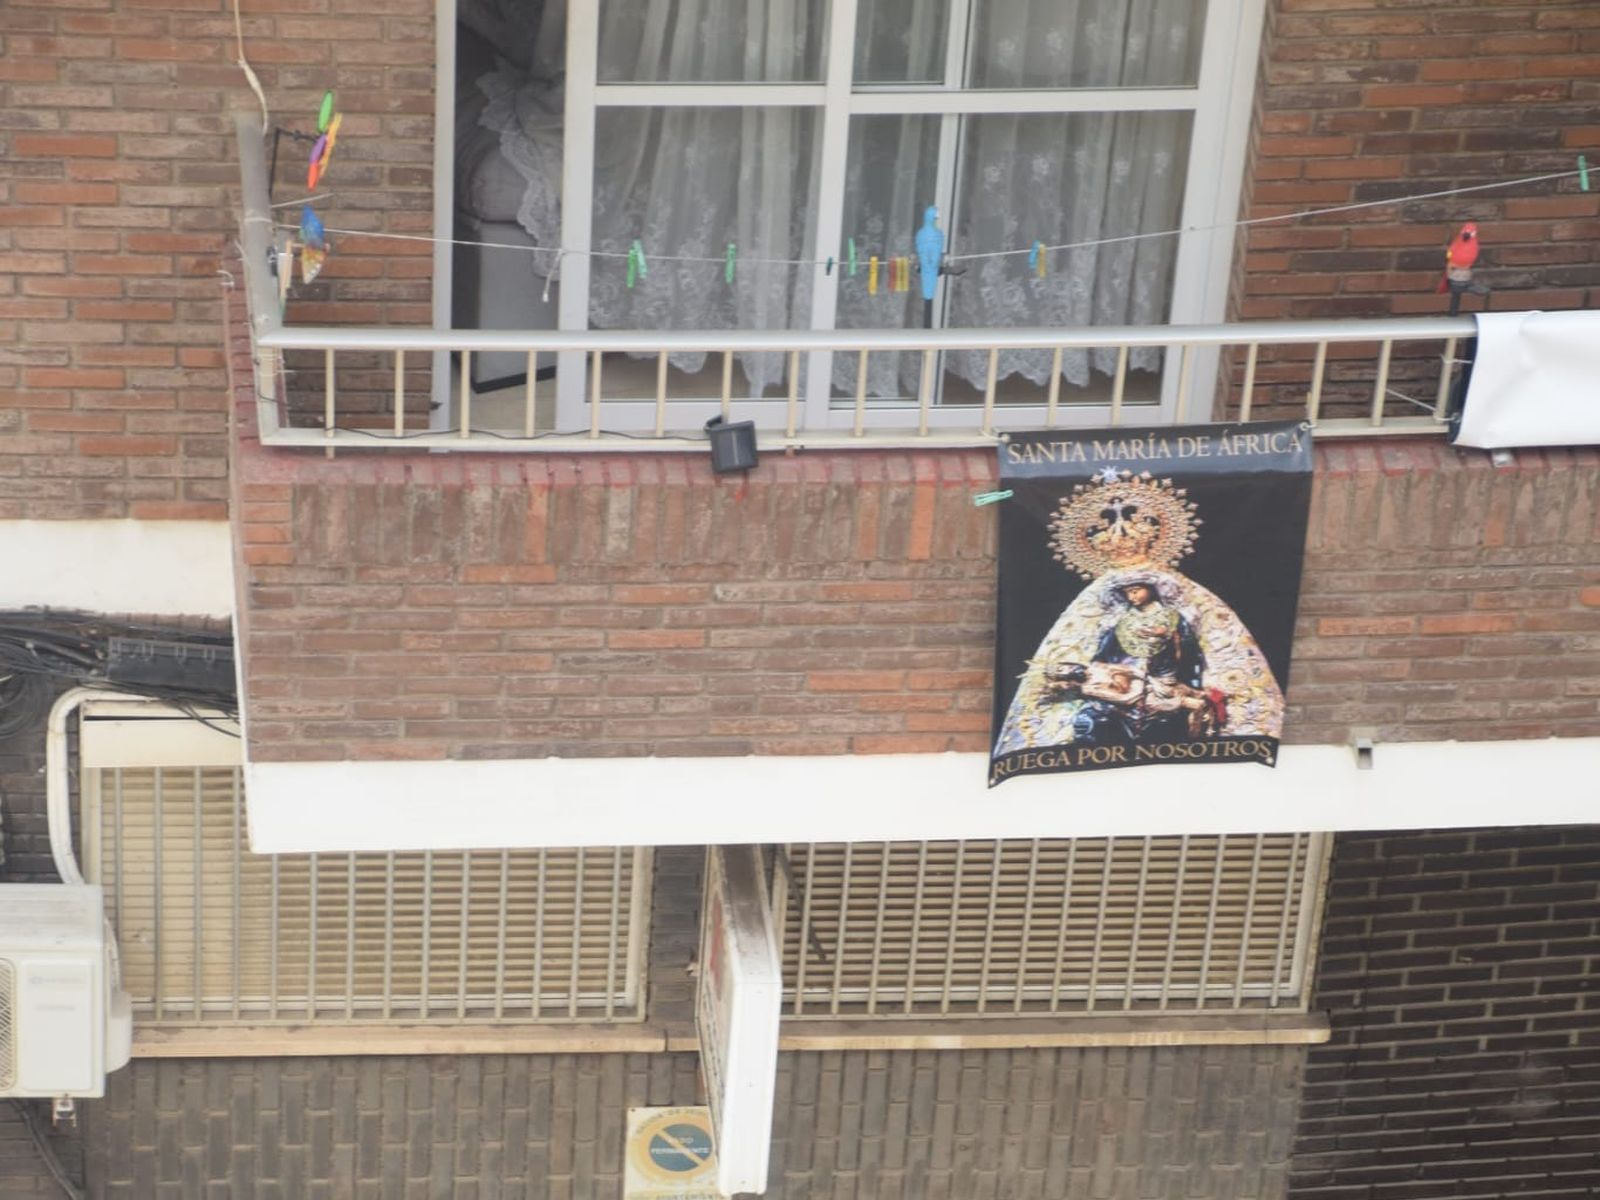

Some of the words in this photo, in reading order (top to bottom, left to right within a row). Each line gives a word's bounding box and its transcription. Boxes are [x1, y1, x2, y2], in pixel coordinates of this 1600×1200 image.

[1008, 441, 1087, 464] SANTA
[1092, 433, 1171, 462] MARÍA
[1178, 437, 1210, 458] DE
[1217, 430, 1304, 456] ÁFRICA
[993, 752, 1071, 779] RUEGA
[1078, 746, 1127, 767] POR
[1134, 740, 1272, 761] NOSOTROS
